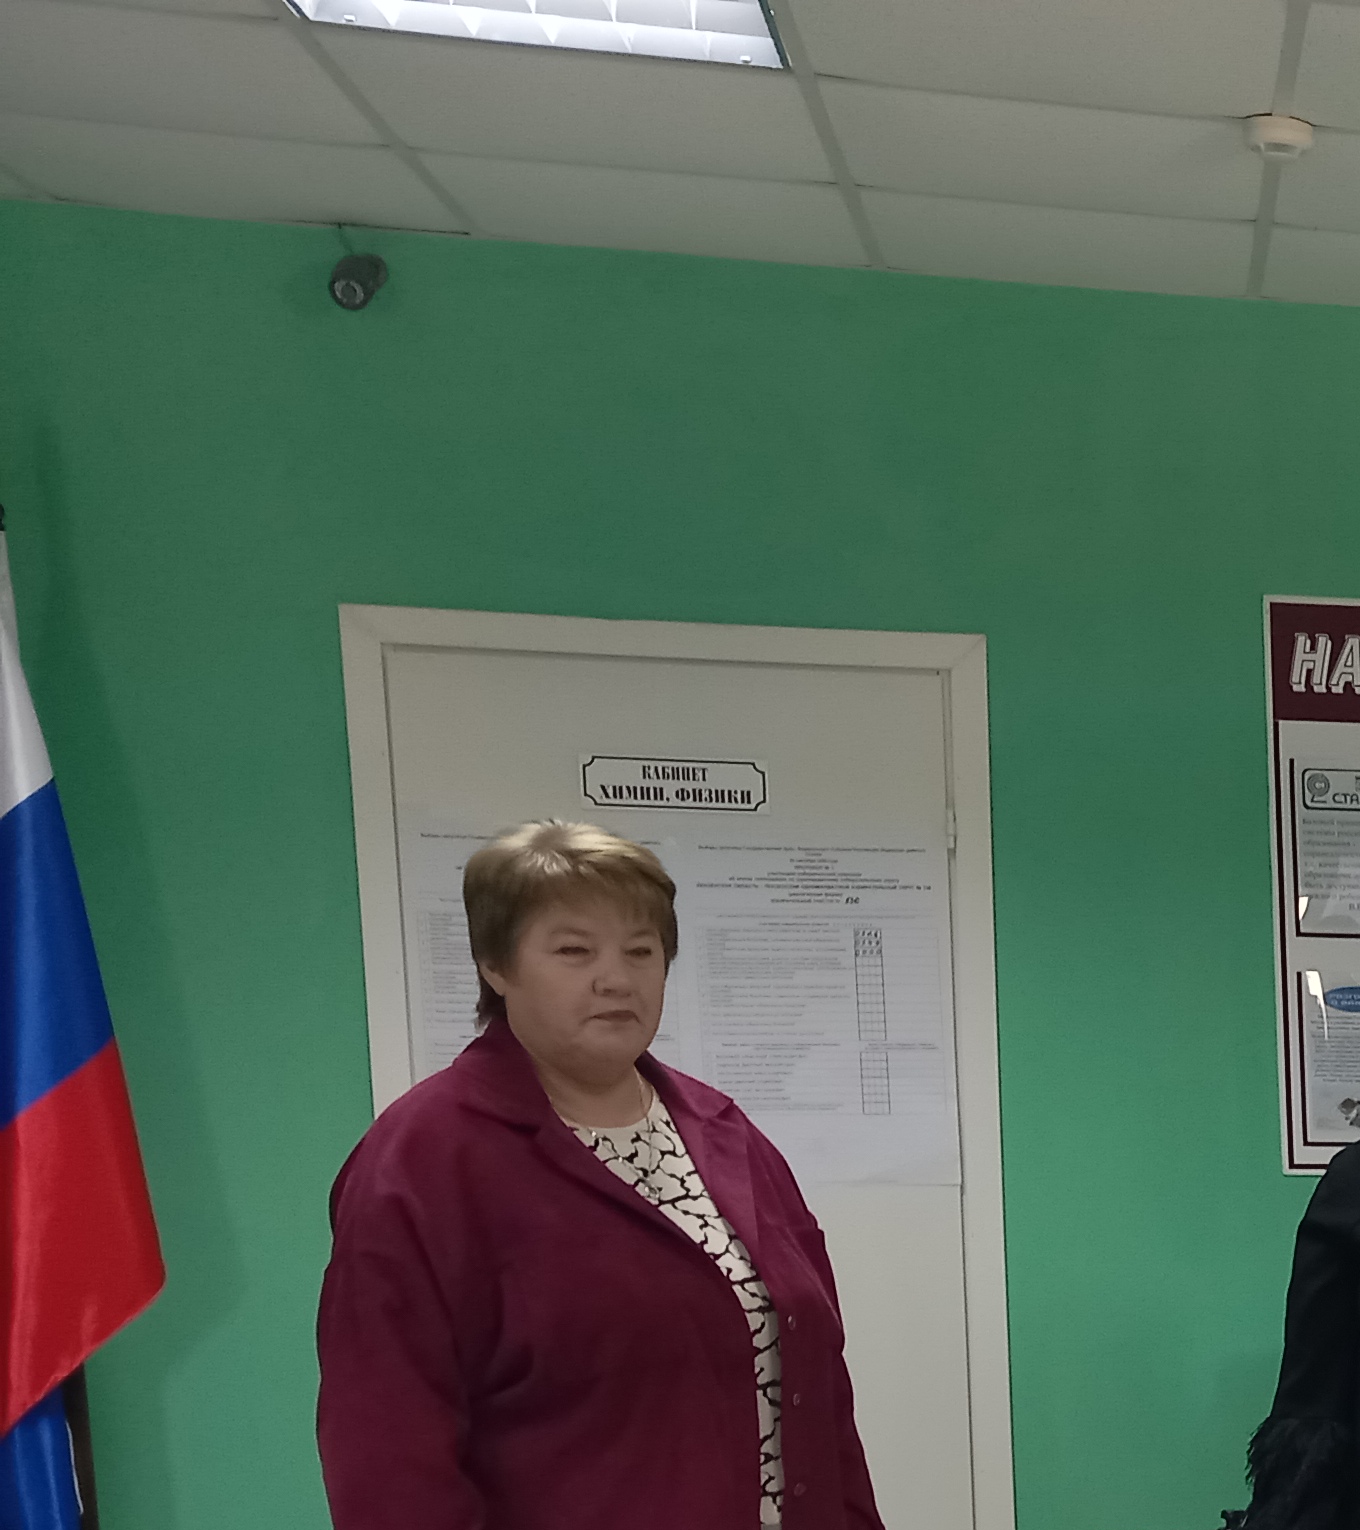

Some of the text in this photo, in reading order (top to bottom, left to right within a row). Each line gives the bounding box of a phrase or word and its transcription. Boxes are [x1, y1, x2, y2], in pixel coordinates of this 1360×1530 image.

[642, 765, 708, 782] КАБИНЕТ
[600, 784, 752, 805] ХИМИИ, ФИЗИКИ
